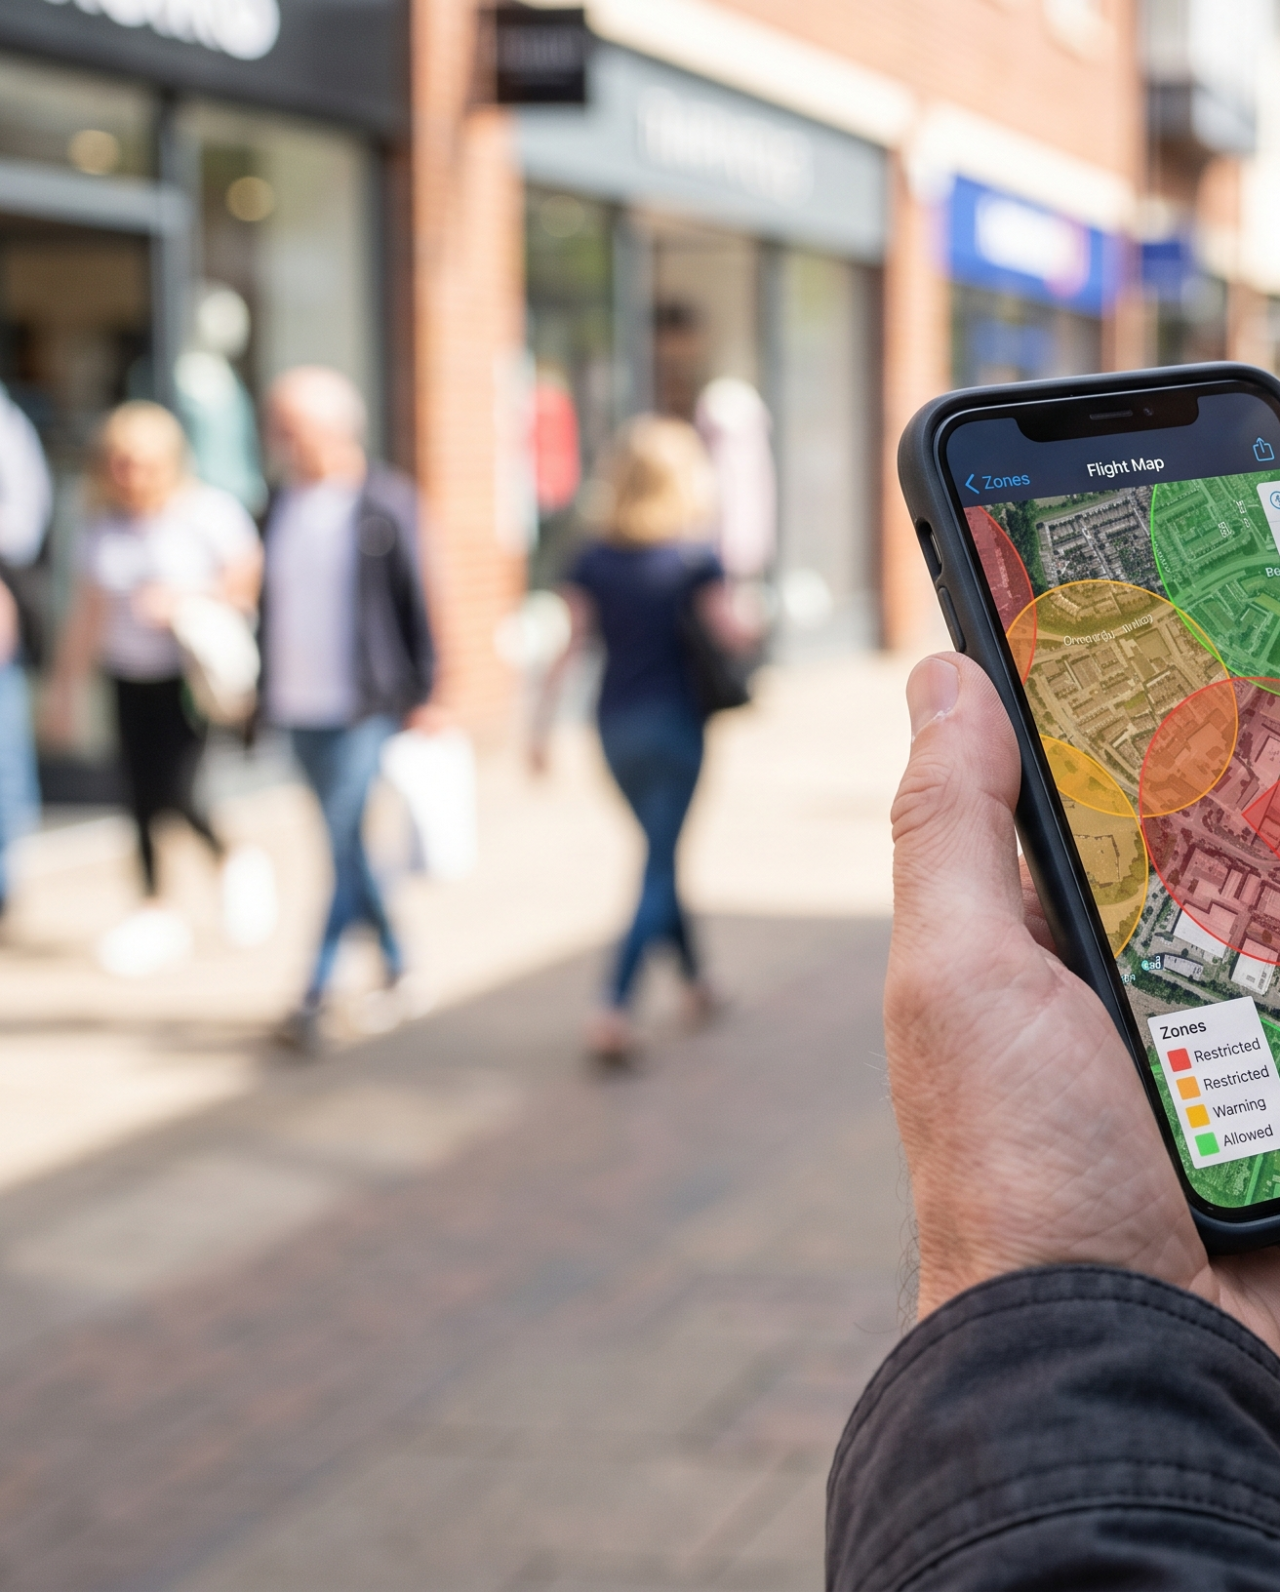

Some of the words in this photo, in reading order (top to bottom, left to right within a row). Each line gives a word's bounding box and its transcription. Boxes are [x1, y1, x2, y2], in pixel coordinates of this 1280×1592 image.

[1086, 460, 1130, 478] Flight
[1131, 457, 1165, 472] Map
[982, 474, 1031, 490] Zones
[1160, 1021, 1207, 1040] Zones
[1194, 1038, 1261, 1063] Restricted
[1203, 1065, 1270, 1091] Restricted
[1213, 1098, 1267, 1118] Warning
[1223, 1124, 1274, 1147] Allowed
